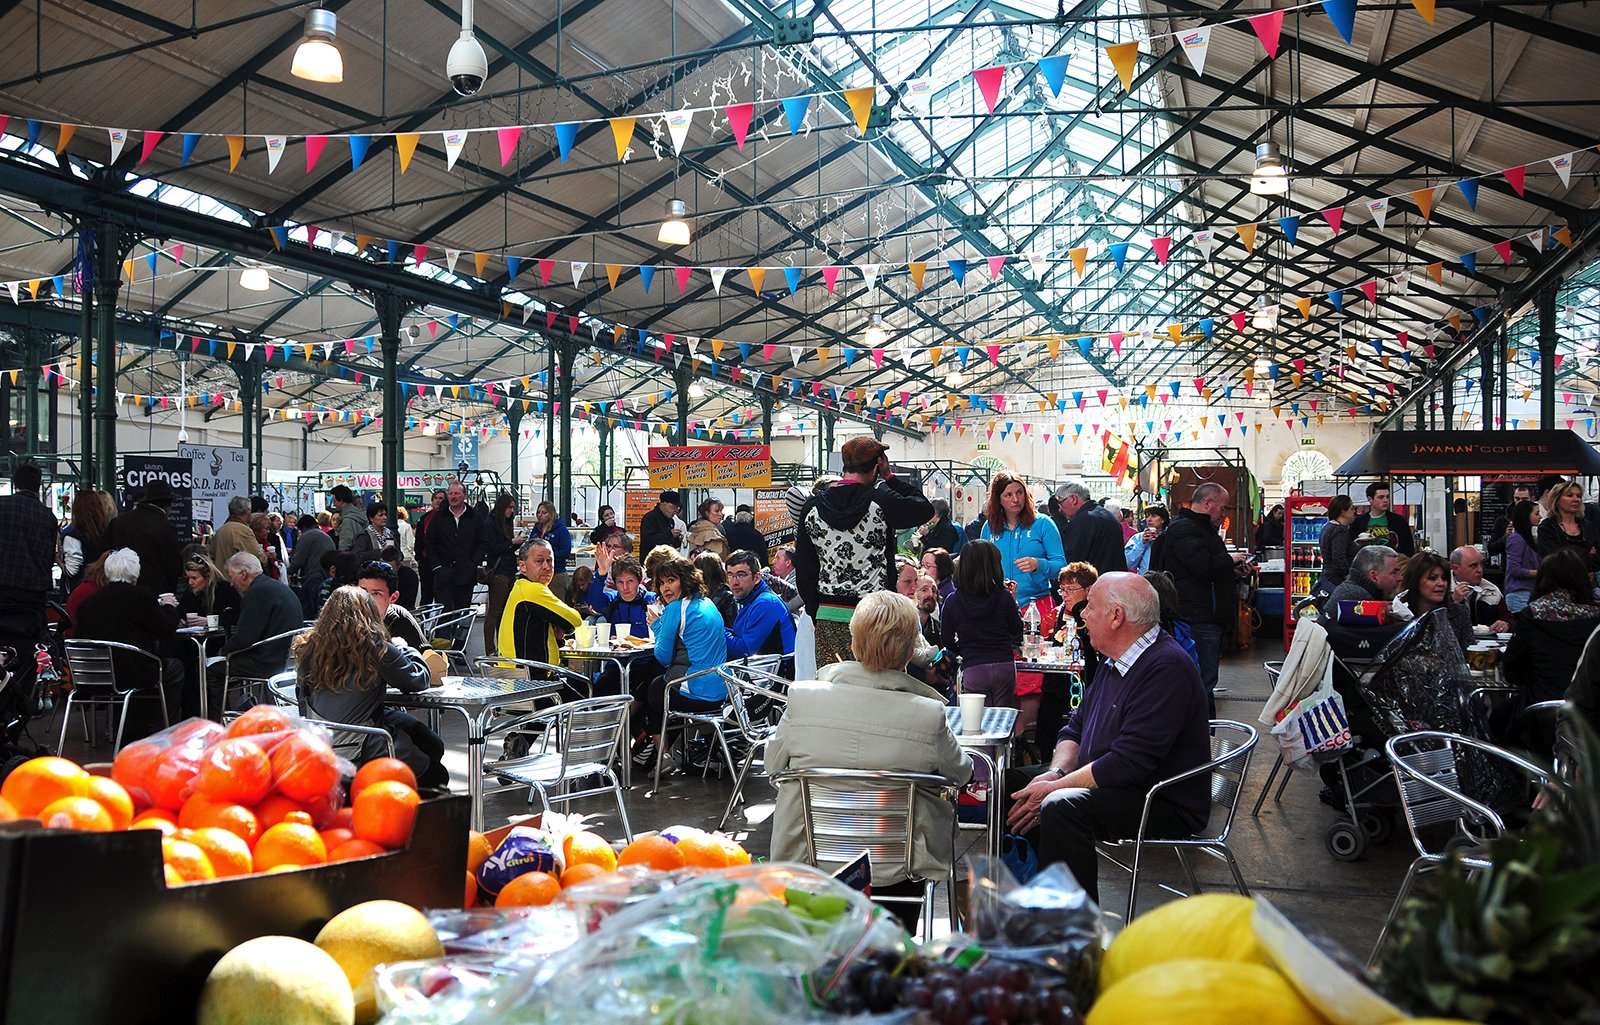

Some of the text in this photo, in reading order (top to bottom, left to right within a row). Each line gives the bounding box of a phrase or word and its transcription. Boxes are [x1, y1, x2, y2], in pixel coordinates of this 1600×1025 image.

[180, 448, 206, 461] Coffee
[704, 448, 722, 459] N
[1412, 444, 1550, 454] JAVAMAN COFFEE
[230, 451, 244, 462] Tea
[192, 479, 211, 490] S.D.
[357, 474, 384, 487] Wee
[1307, 730, 1352, 755] ESCO
